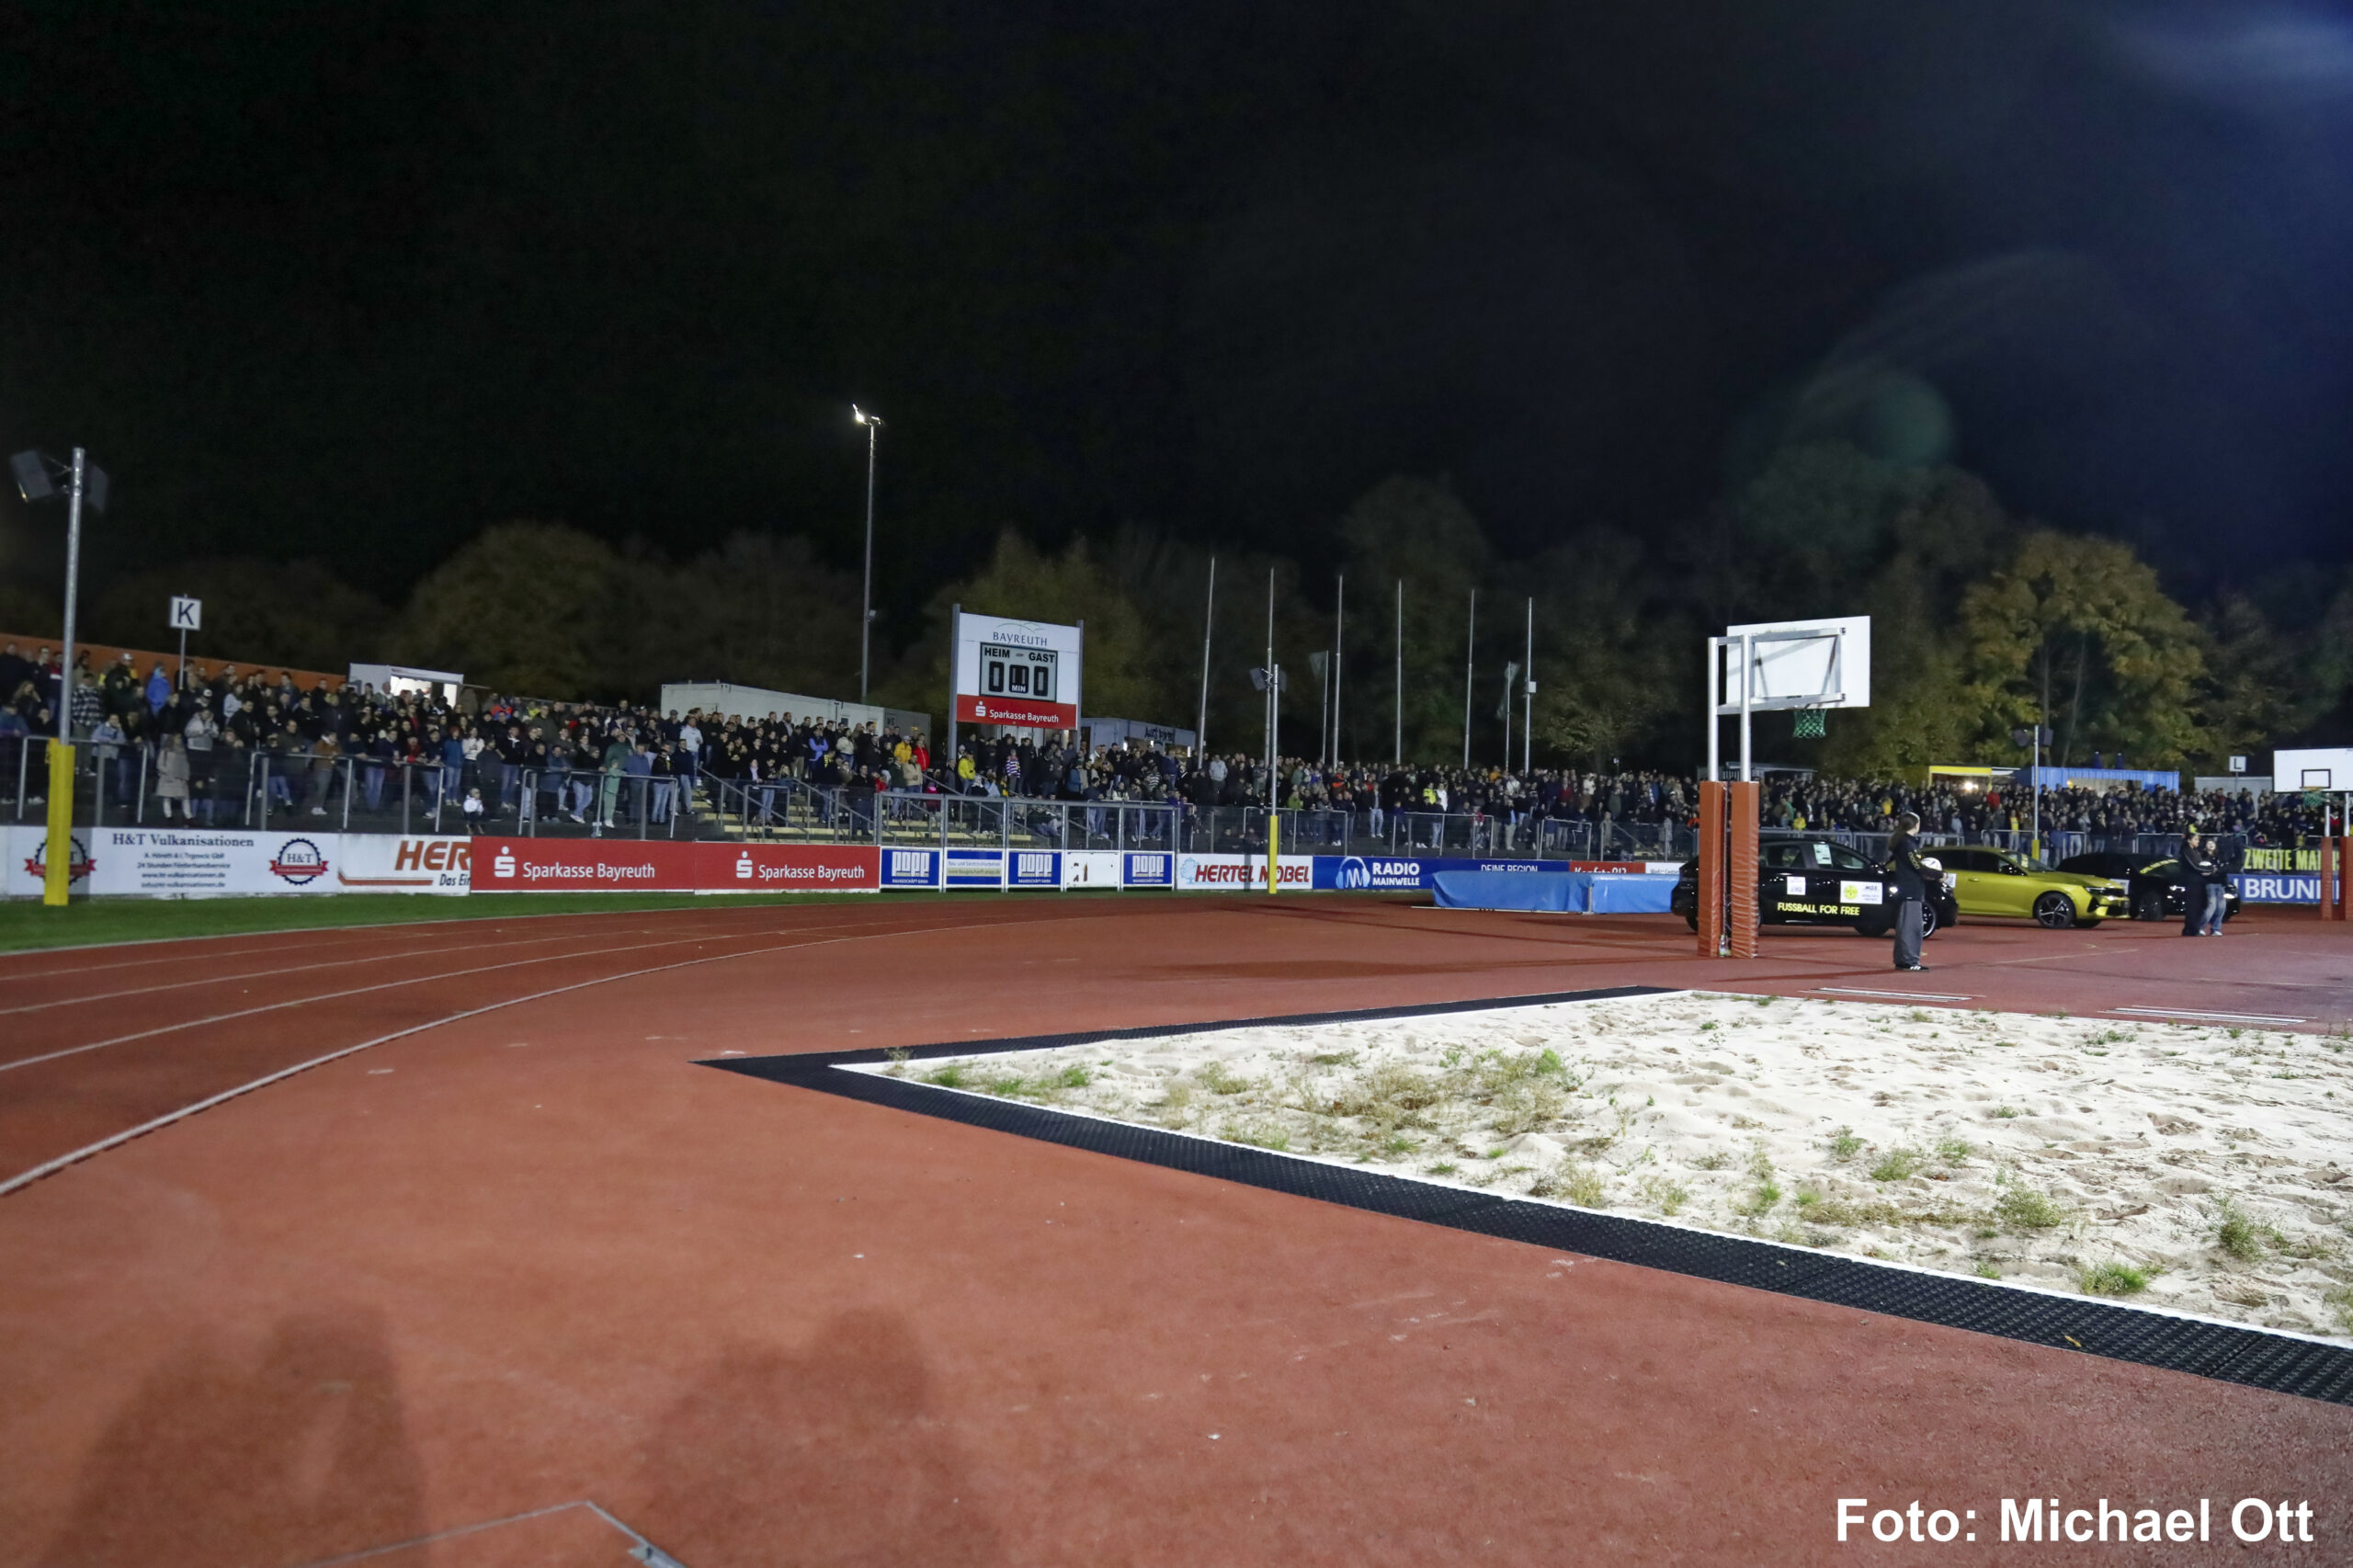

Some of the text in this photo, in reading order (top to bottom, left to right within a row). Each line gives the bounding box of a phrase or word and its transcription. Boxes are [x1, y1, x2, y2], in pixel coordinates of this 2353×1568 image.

[177, 601, 195, 626] K
[993, 631, 1048, 646] BAYREUTH
[984, 647, 1010, 658] HEIM
[1029, 652, 1055, 663] GAST
[989, 710, 1059, 723] Sparkasse Bayreuth
[2234, 757, 2242, 769] L
[112, 833, 255, 847] H&T Vulkanisationen
[287, 853, 314, 863] H&T
[394, 840, 471, 870] HER
[2244, 848, 2292, 870] ZWEITE
[523, 862, 655, 881] Sparkasse Bayreuth
[758, 864, 865, 881] Sparkasse Bayreuth
[1194, 865, 1254, 883] HERTEL
[1372, 862, 1420, 876] RADIO
[439, 874, 456, 886] Das
[1372, 877, 1420, 886] MAINWELLE
[1777, 902, 1860, 915] FUSSBALL FOR FREE
